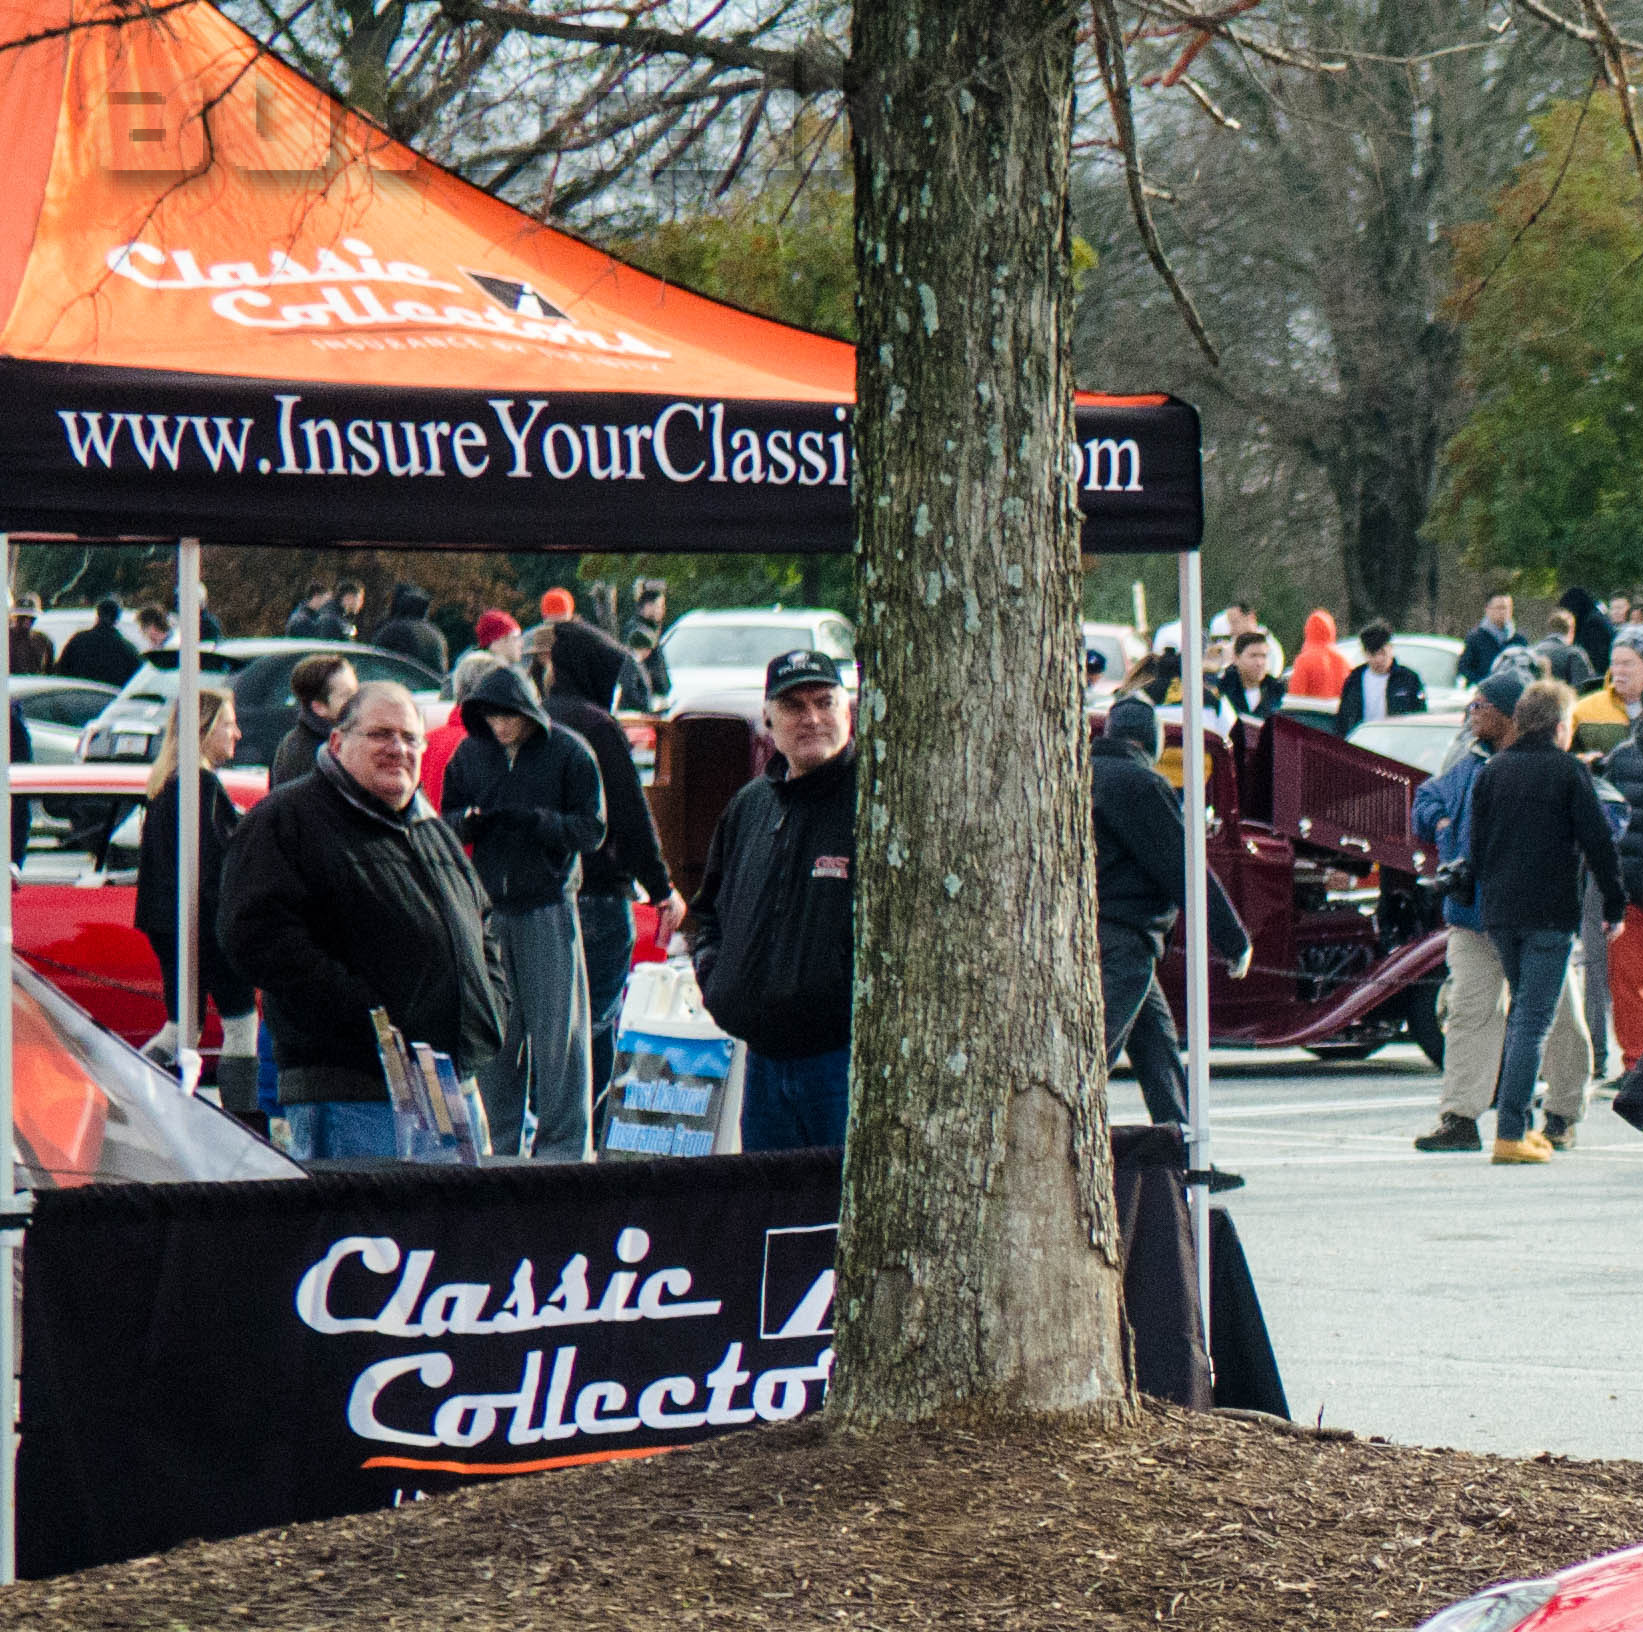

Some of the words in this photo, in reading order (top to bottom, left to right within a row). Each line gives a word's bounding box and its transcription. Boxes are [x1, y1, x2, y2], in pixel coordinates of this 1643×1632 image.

[108, 237, 462, 294] Classic
[210, 286, 672, 359] Collectors
[296, 1226, 721, 1337] Classic
